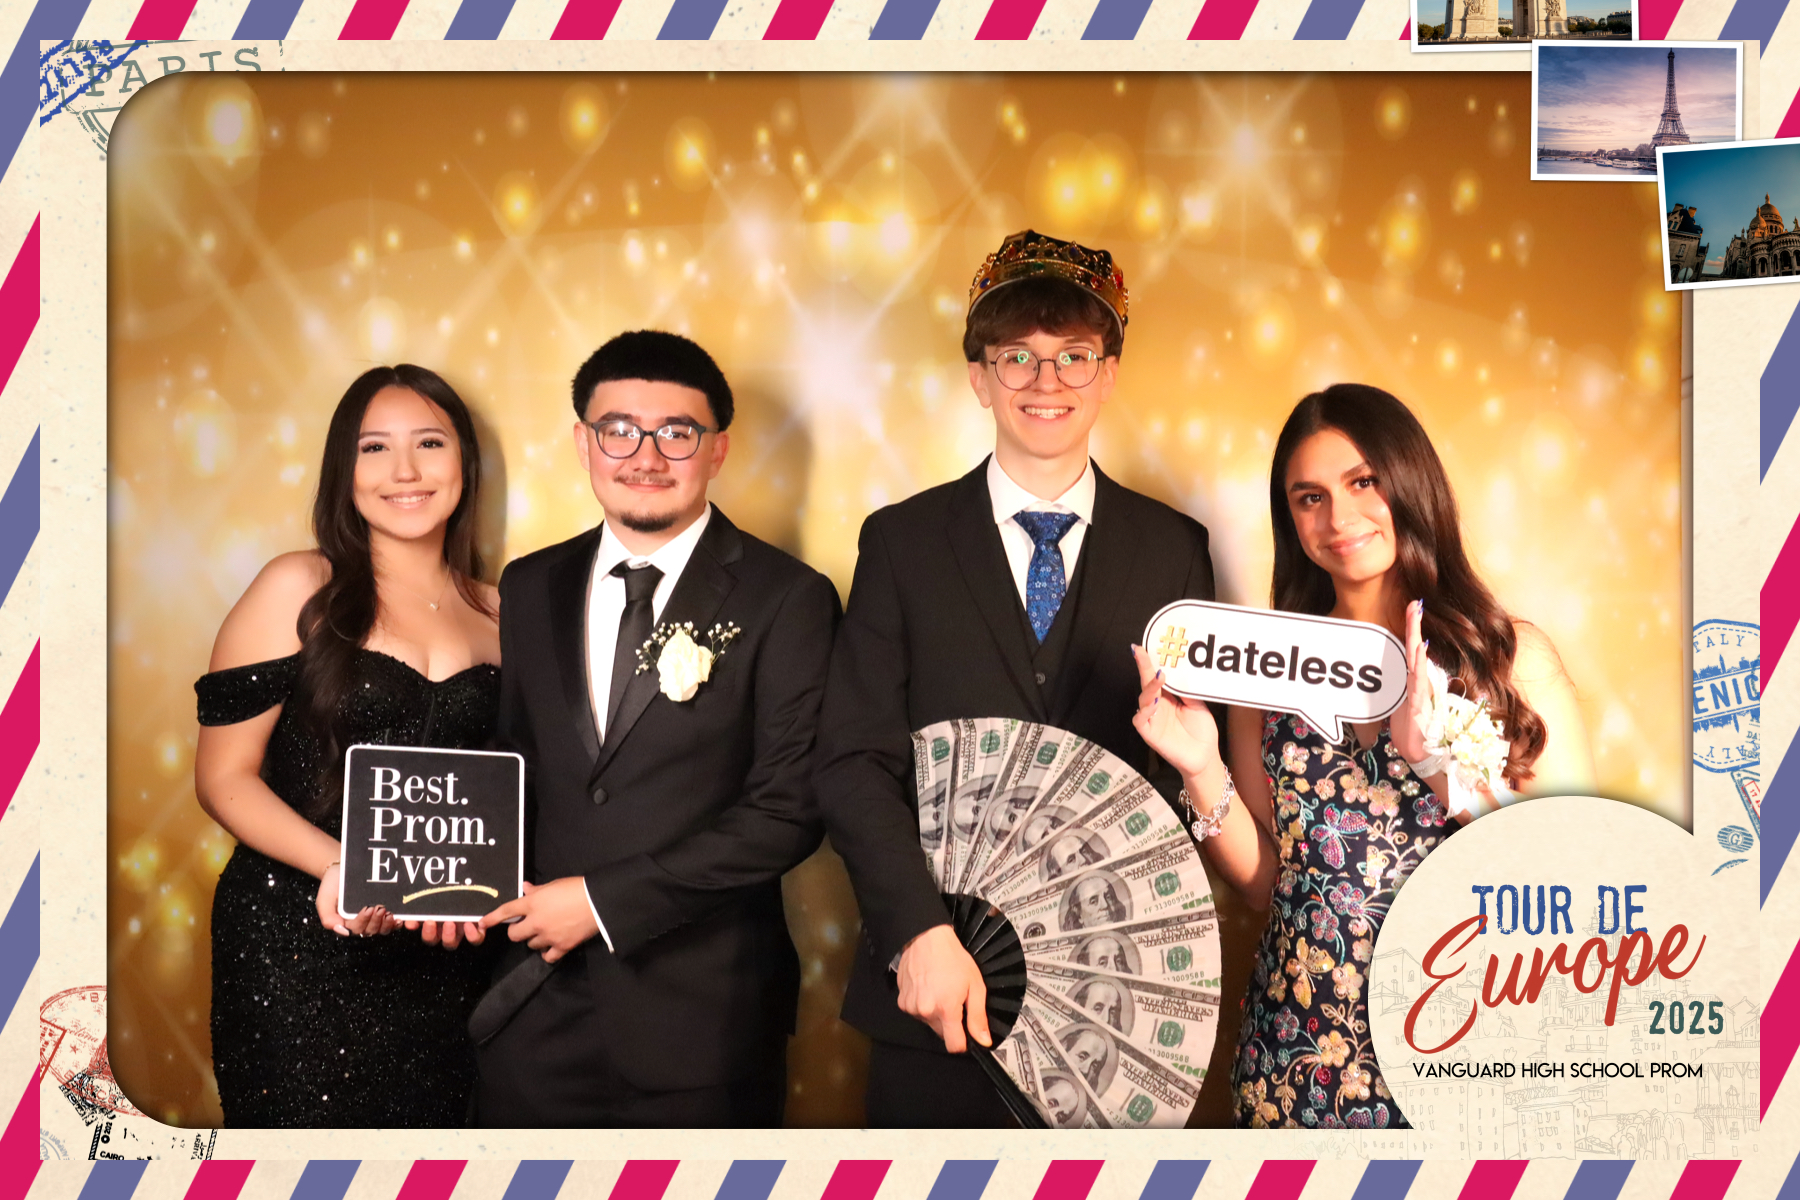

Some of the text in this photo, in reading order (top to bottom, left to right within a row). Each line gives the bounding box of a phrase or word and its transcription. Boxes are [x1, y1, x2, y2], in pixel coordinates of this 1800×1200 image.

[1157, 625, 1383, 693] #dateless
[369, 766, 469, 805] Best.
[368, 806, 496, 846] Prom.
[366, 847, 472, 885] Ever.
